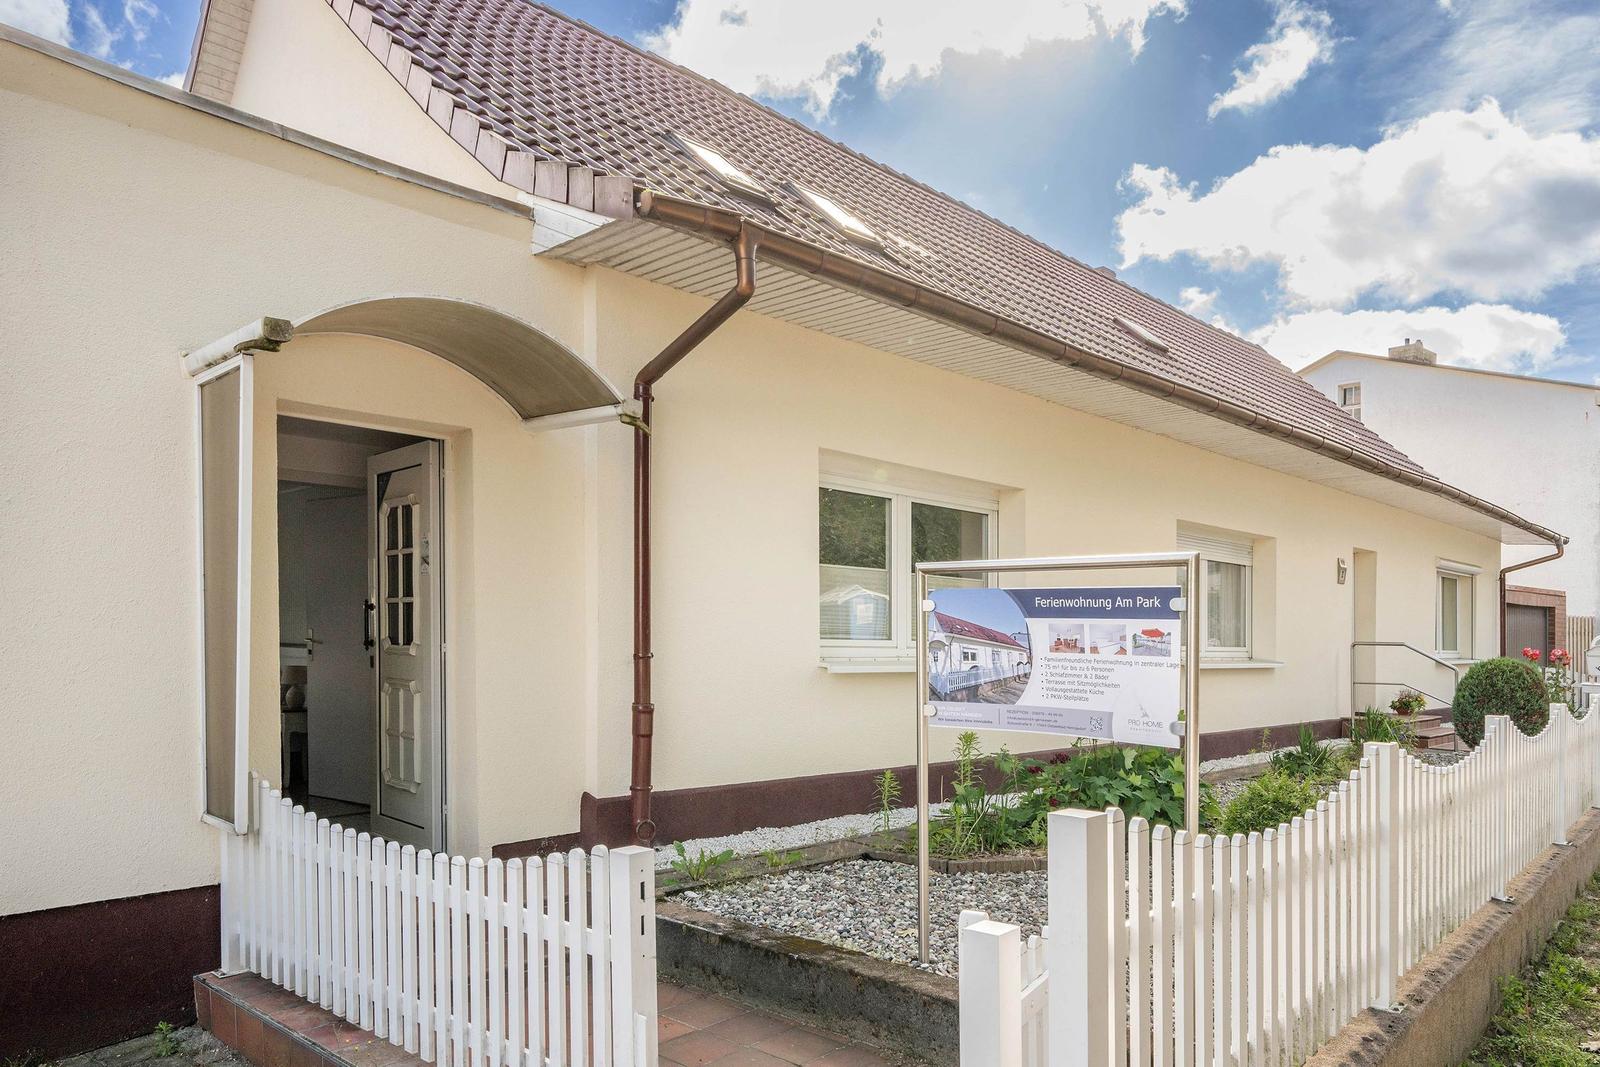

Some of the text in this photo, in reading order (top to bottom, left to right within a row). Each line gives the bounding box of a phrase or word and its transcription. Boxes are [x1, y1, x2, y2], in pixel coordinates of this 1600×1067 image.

[1035, 596, 1161, 610] Ferienwohnung Am Park
[1093, 659, 1133, 667] Ferienwohnung
[1127, 718, 1164, 729] PRO HOME
